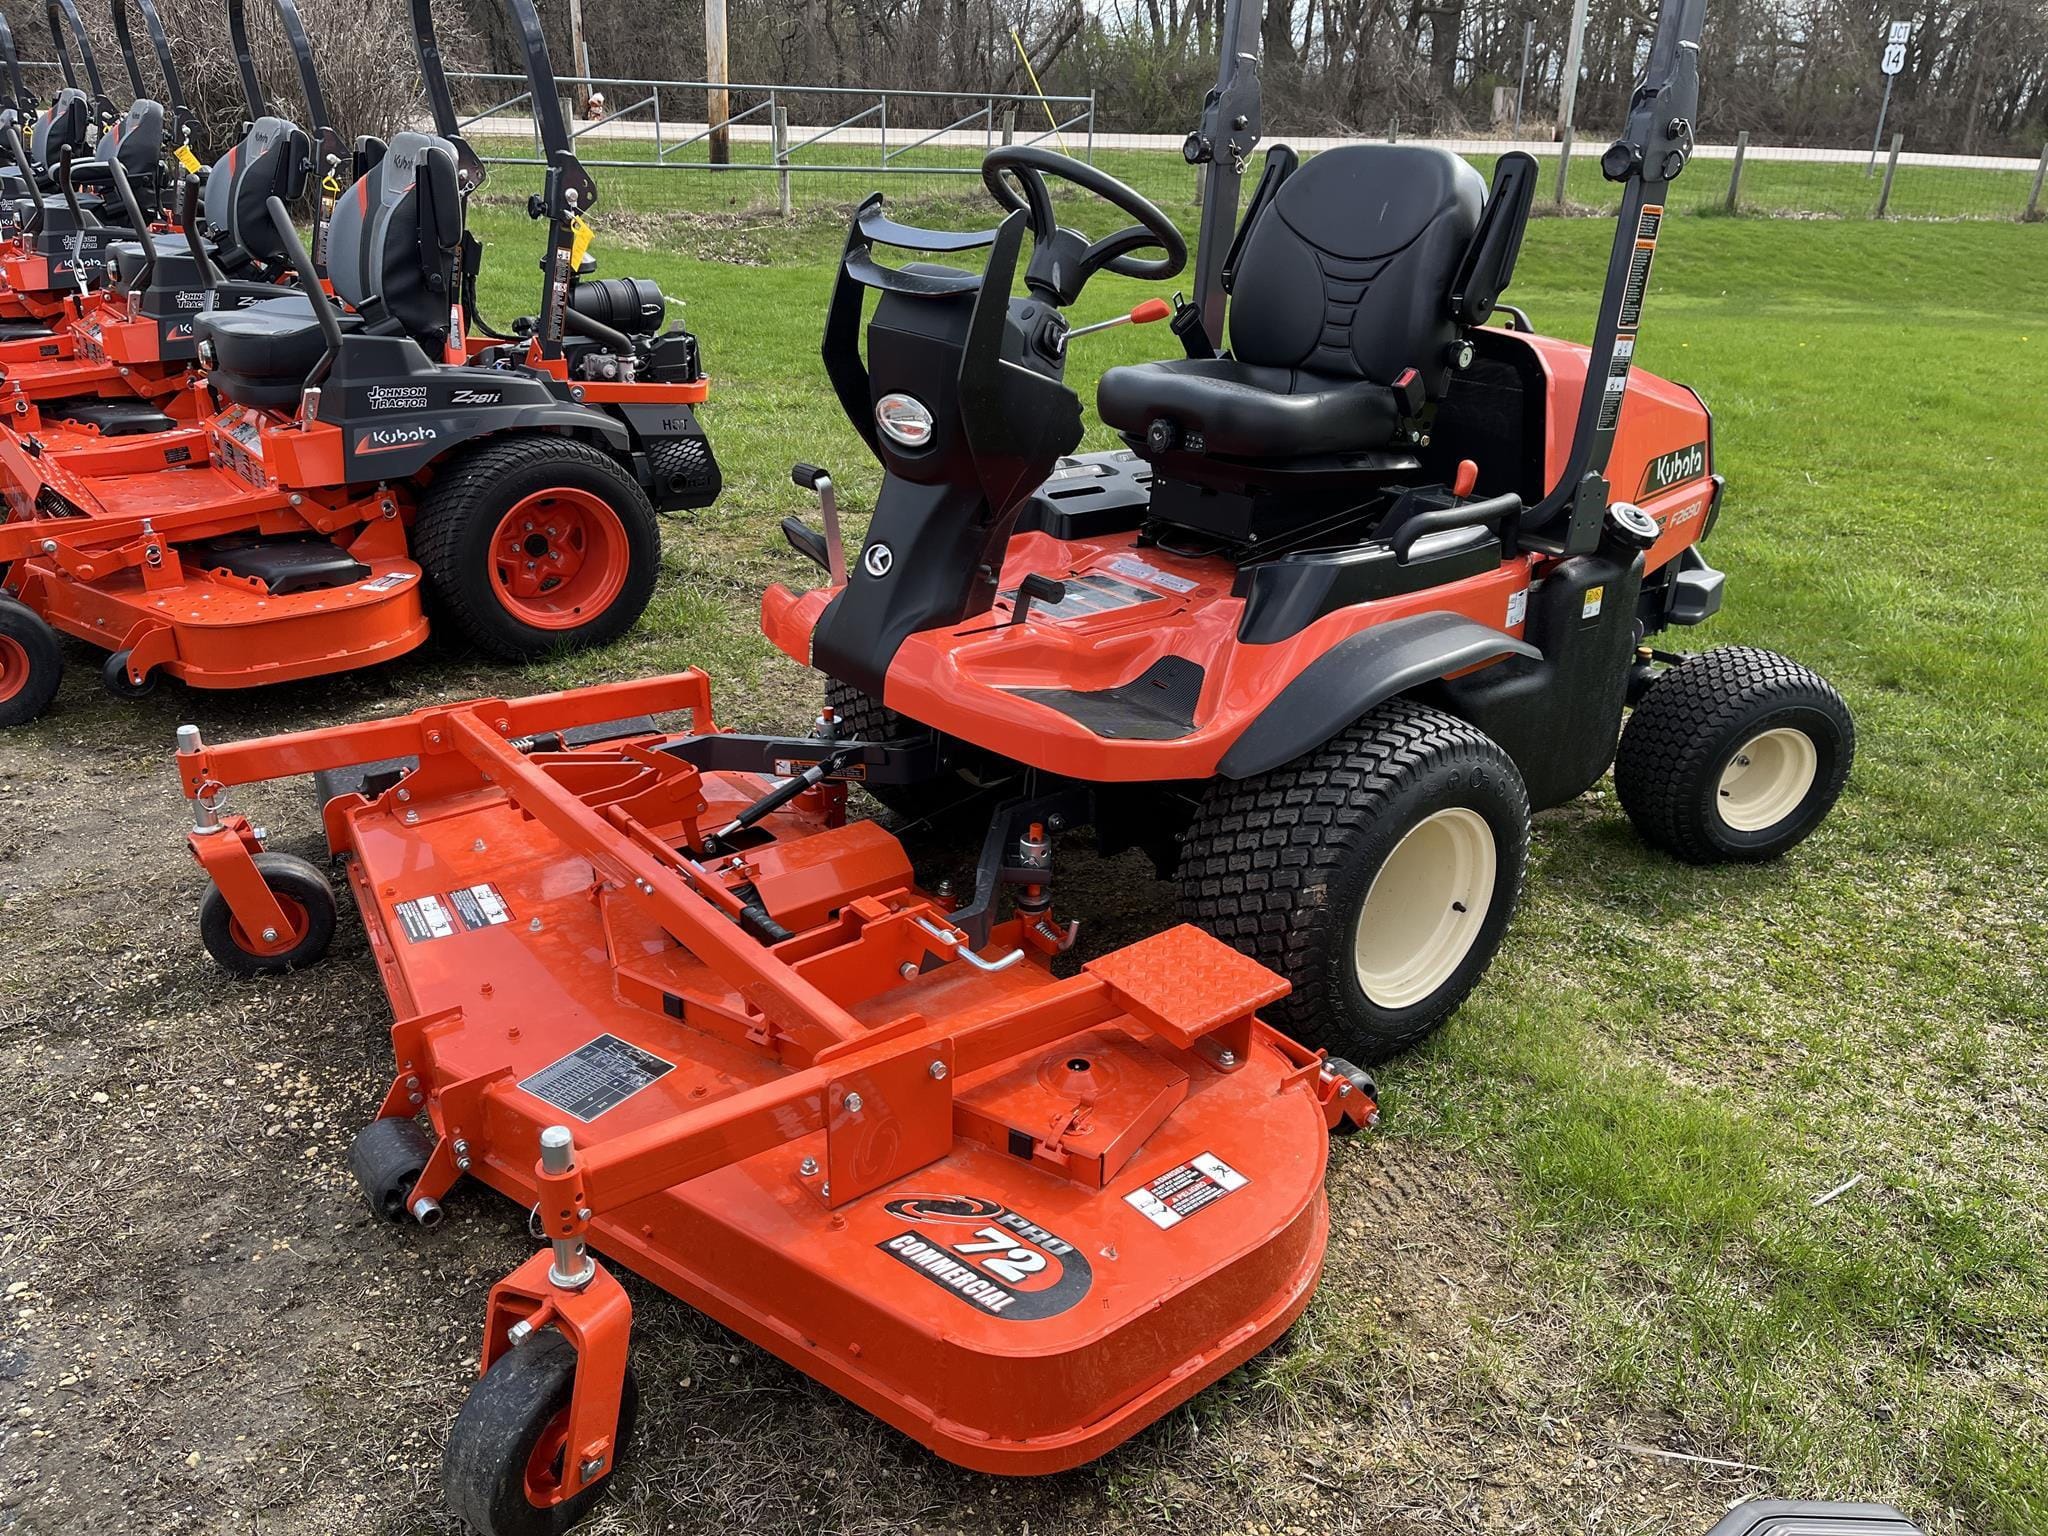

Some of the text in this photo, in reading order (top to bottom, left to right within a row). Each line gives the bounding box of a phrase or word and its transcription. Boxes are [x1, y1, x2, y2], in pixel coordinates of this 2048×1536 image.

[1890, 25, 1909, 39] JCT
[1886, 50, 1901, 68] 14
[367, 386, 427, 398] JOHNSON
[369, 398, 427, 409] TRACTOR
[372, 426, 437, 444] Kubota
[1656, 445, 1702, 486] Kubota
[1159, 1164, 1188, 1183] DANGER
[997, 1213, 1075, 1256] PRO
[952, 1226, 1048, 1284] 72
[887, 1234, 1017, 1313] COMMERCIAL
